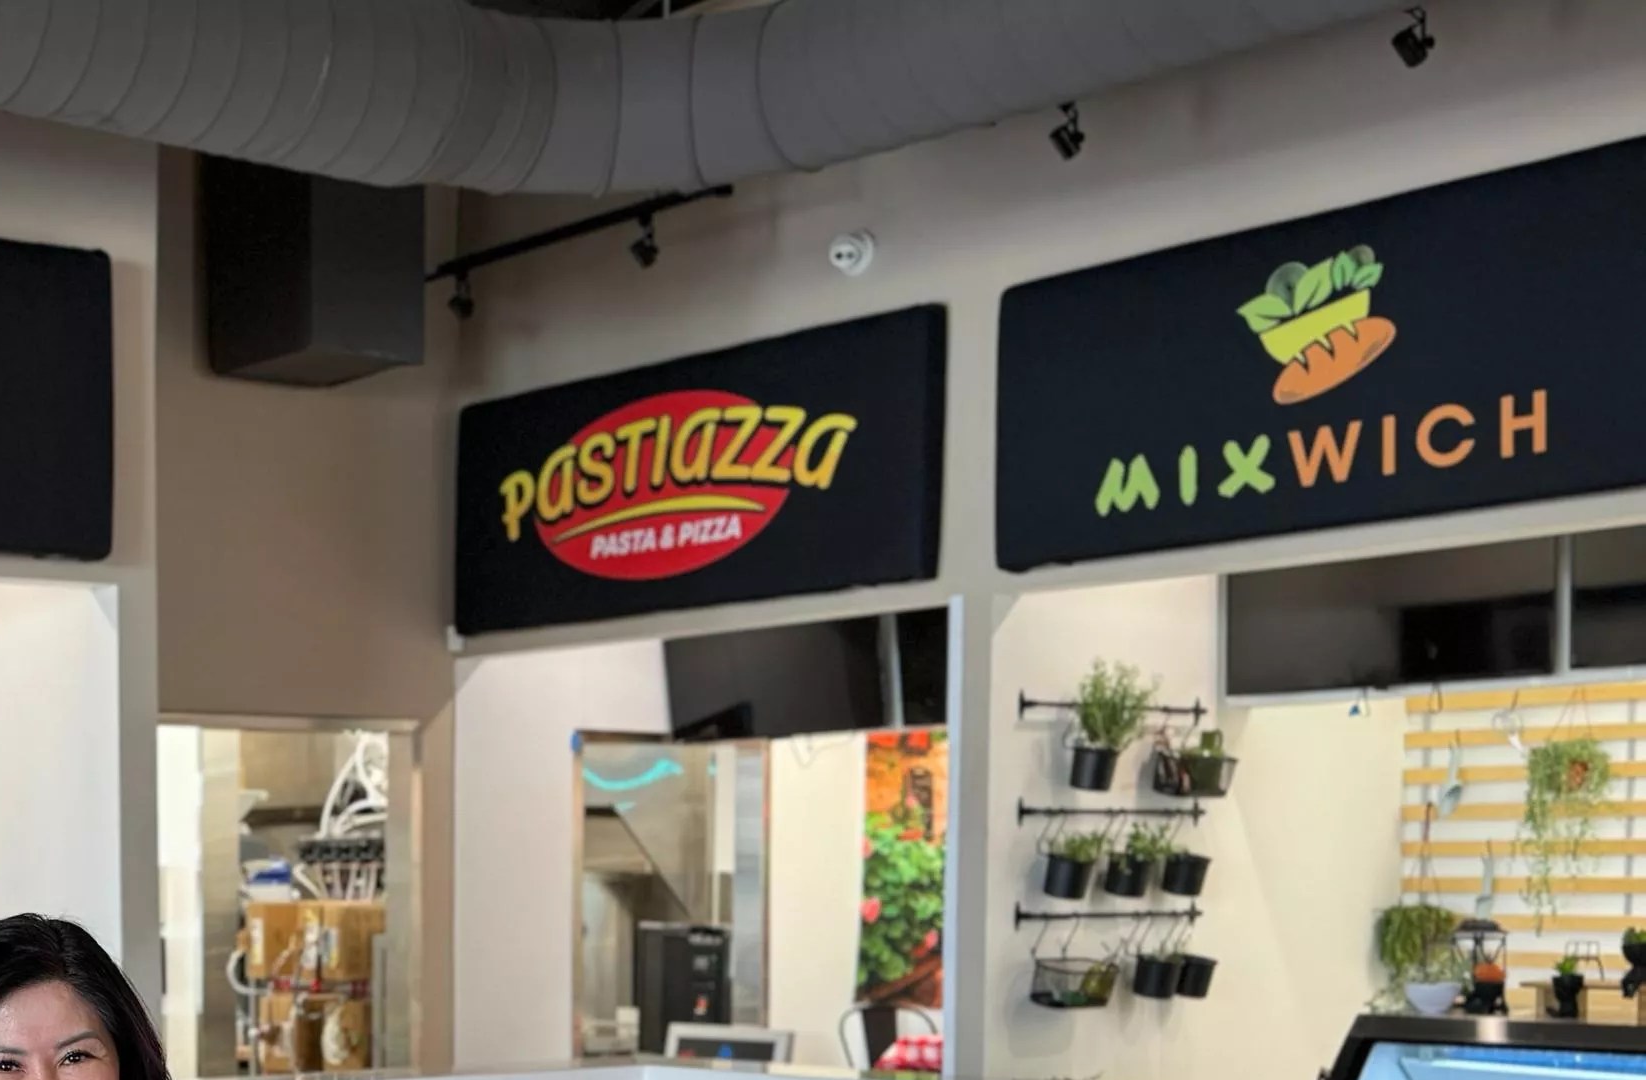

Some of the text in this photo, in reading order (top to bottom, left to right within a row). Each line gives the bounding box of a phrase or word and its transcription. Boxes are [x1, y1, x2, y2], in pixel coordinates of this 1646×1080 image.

[1095, 389, 1548, 517] MIXWICH
[590, 515, 743, 559] PASTA & PIZZA
